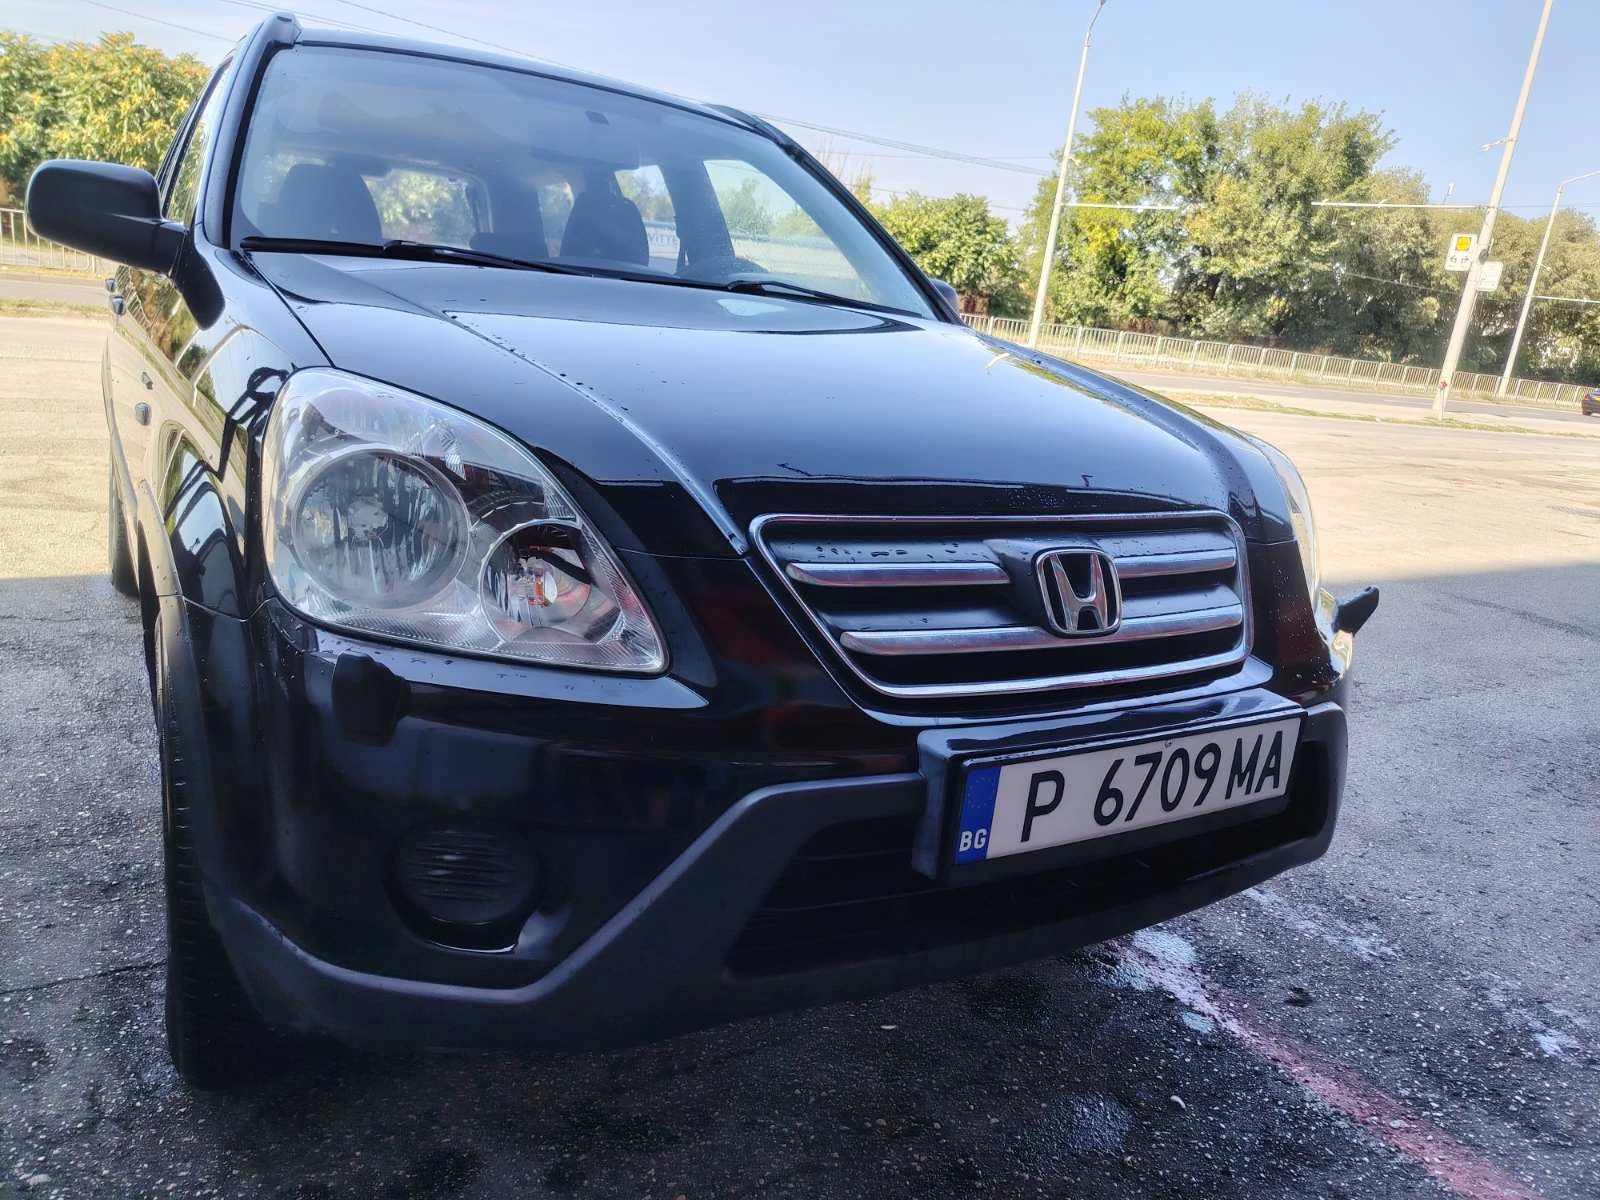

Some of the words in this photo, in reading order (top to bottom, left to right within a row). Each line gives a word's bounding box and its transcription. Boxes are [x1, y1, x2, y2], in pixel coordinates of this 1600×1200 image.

[1020, 770, 1065, 842] P
[1094, 743, 1221, 826] 6709
[1225, 731, 1283, 800] MA
[959, 828, 988, 852] BG
